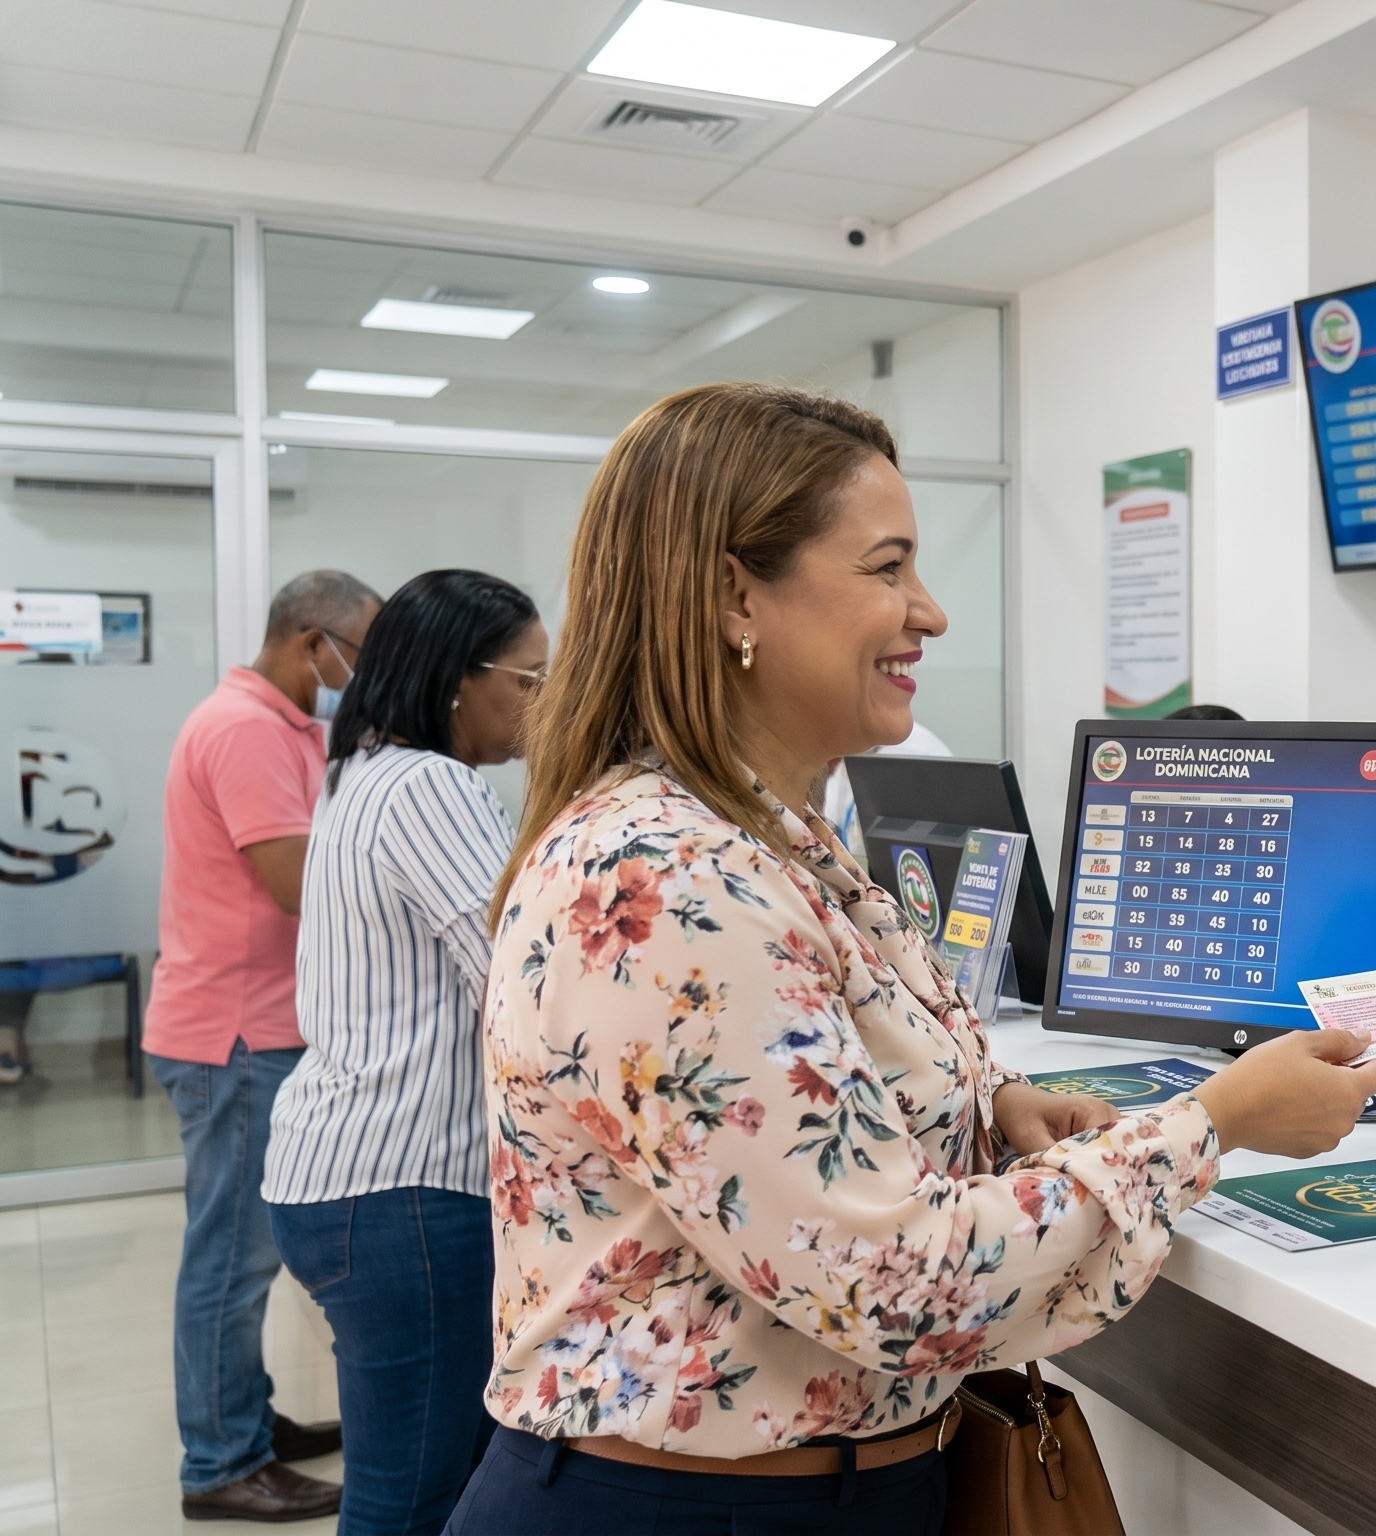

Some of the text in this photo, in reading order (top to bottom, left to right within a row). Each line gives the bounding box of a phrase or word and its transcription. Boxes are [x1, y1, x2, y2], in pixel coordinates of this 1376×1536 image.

[1136, 745, 1275, 763] LOTERÍA NACIONAL
[1154, 763, 1251, 778] DOMINICANA
[1141, 810, 1279, 826] 13 7 4 27
[1138, 835, 1276, 853] 15 14 28 16
[1256, 865, 1274, 878] 30
[1132, 885, 1271, 905] 00 85 40 40
[1209, 916, 1226, 929] 45
[1251, 918, 1268, 931] 10
[970, 927, 986, 941] 200
[1127, 936, 1143, 949] 15
[1165, 939, 1183, 952] 40
[1248, 945, 1265, 958] 30
[1123, 961, 1263, 983] 30 80 70 10
